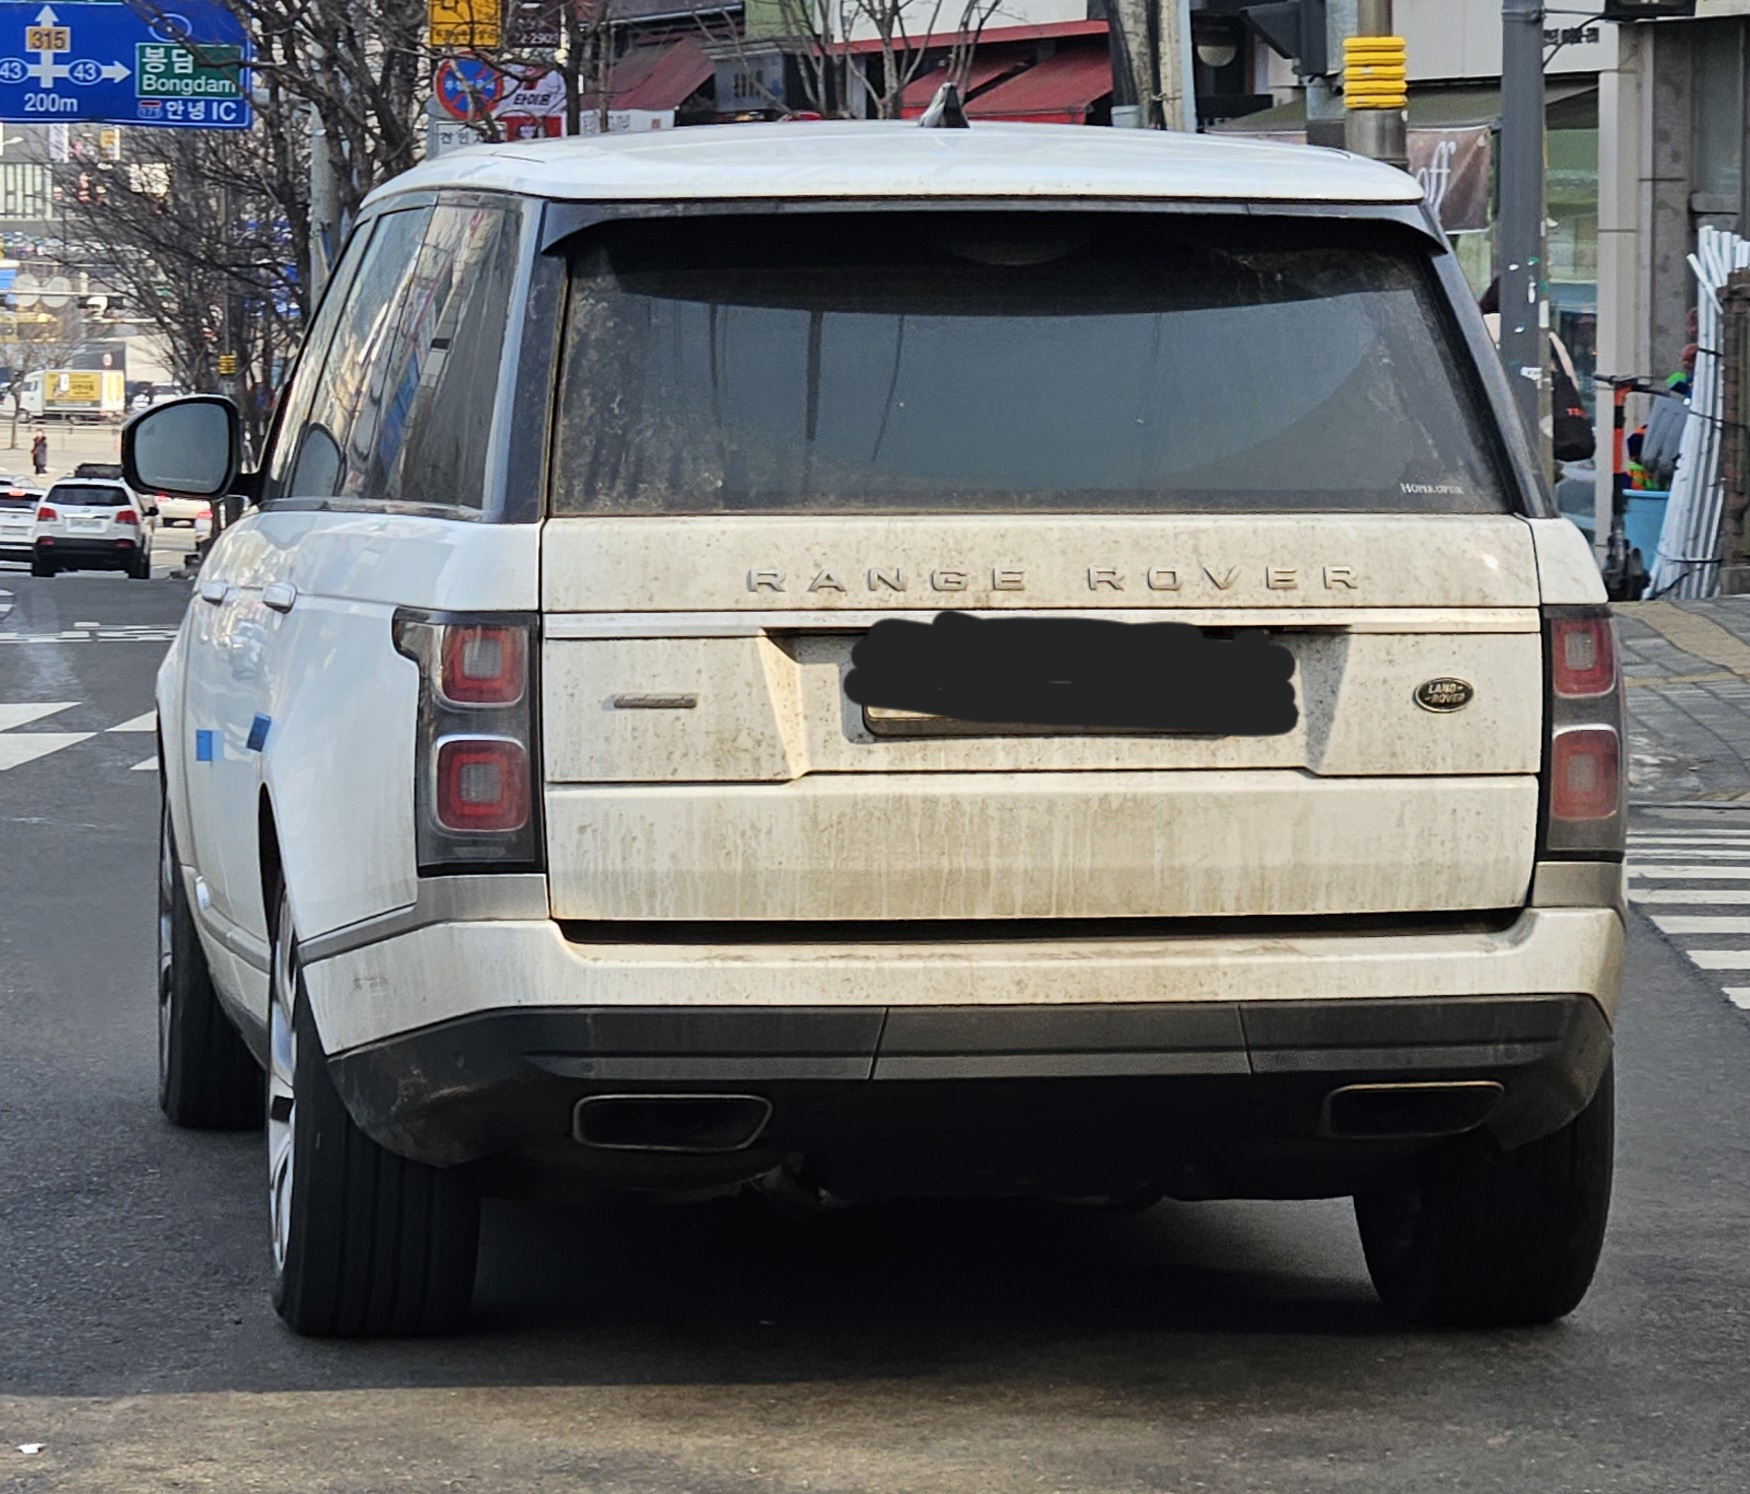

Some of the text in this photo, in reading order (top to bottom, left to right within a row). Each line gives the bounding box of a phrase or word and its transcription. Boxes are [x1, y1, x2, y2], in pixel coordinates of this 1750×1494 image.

[31, 31, 66, 49] 315
[141, 46, 195, 74] 봉담
[0, 61, 23, 80] 43
[73, 63, 97, 81] 43
[142, 74, 236, 95] Bongdam
[24, 92, 78, 112] 200m
[165, 100, 206, 120] 안녕
[211, 101, 237, 121] IC
[747, 564, 1361, 592] RANGE ROVER
[1427, 682, 1457, 694] LAND
[1430, 692, 1466, 704] ROVER
